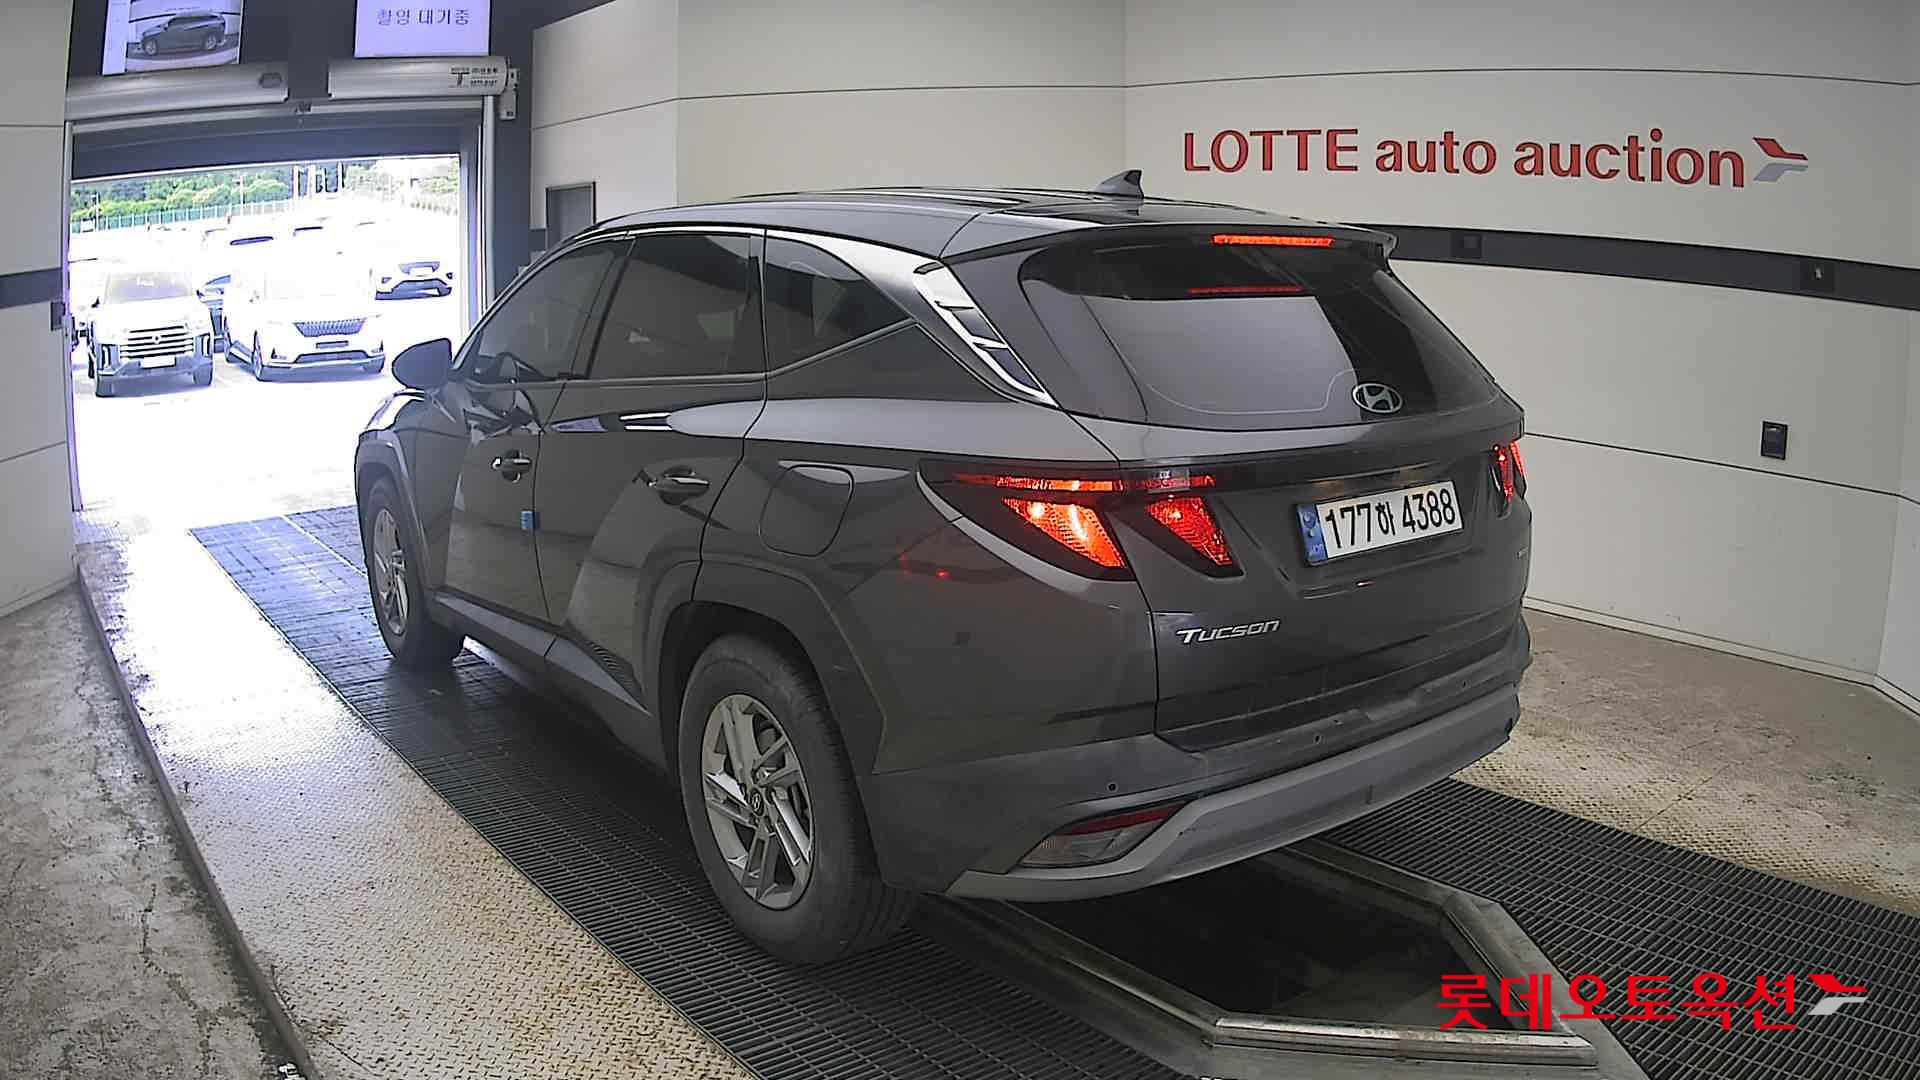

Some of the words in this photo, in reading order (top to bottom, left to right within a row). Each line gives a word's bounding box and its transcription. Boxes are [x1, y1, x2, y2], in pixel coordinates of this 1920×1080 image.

[419, 9, 469, 25] 대기중
[1184, 129, 1359, 172] LOTTE
[1375, 131, 1497, 175] auto
[1513, 129, 1745, 187] auction
[1325, 501, 1396, 549] 177하
[1402, 488, 1456, 533] 4388
